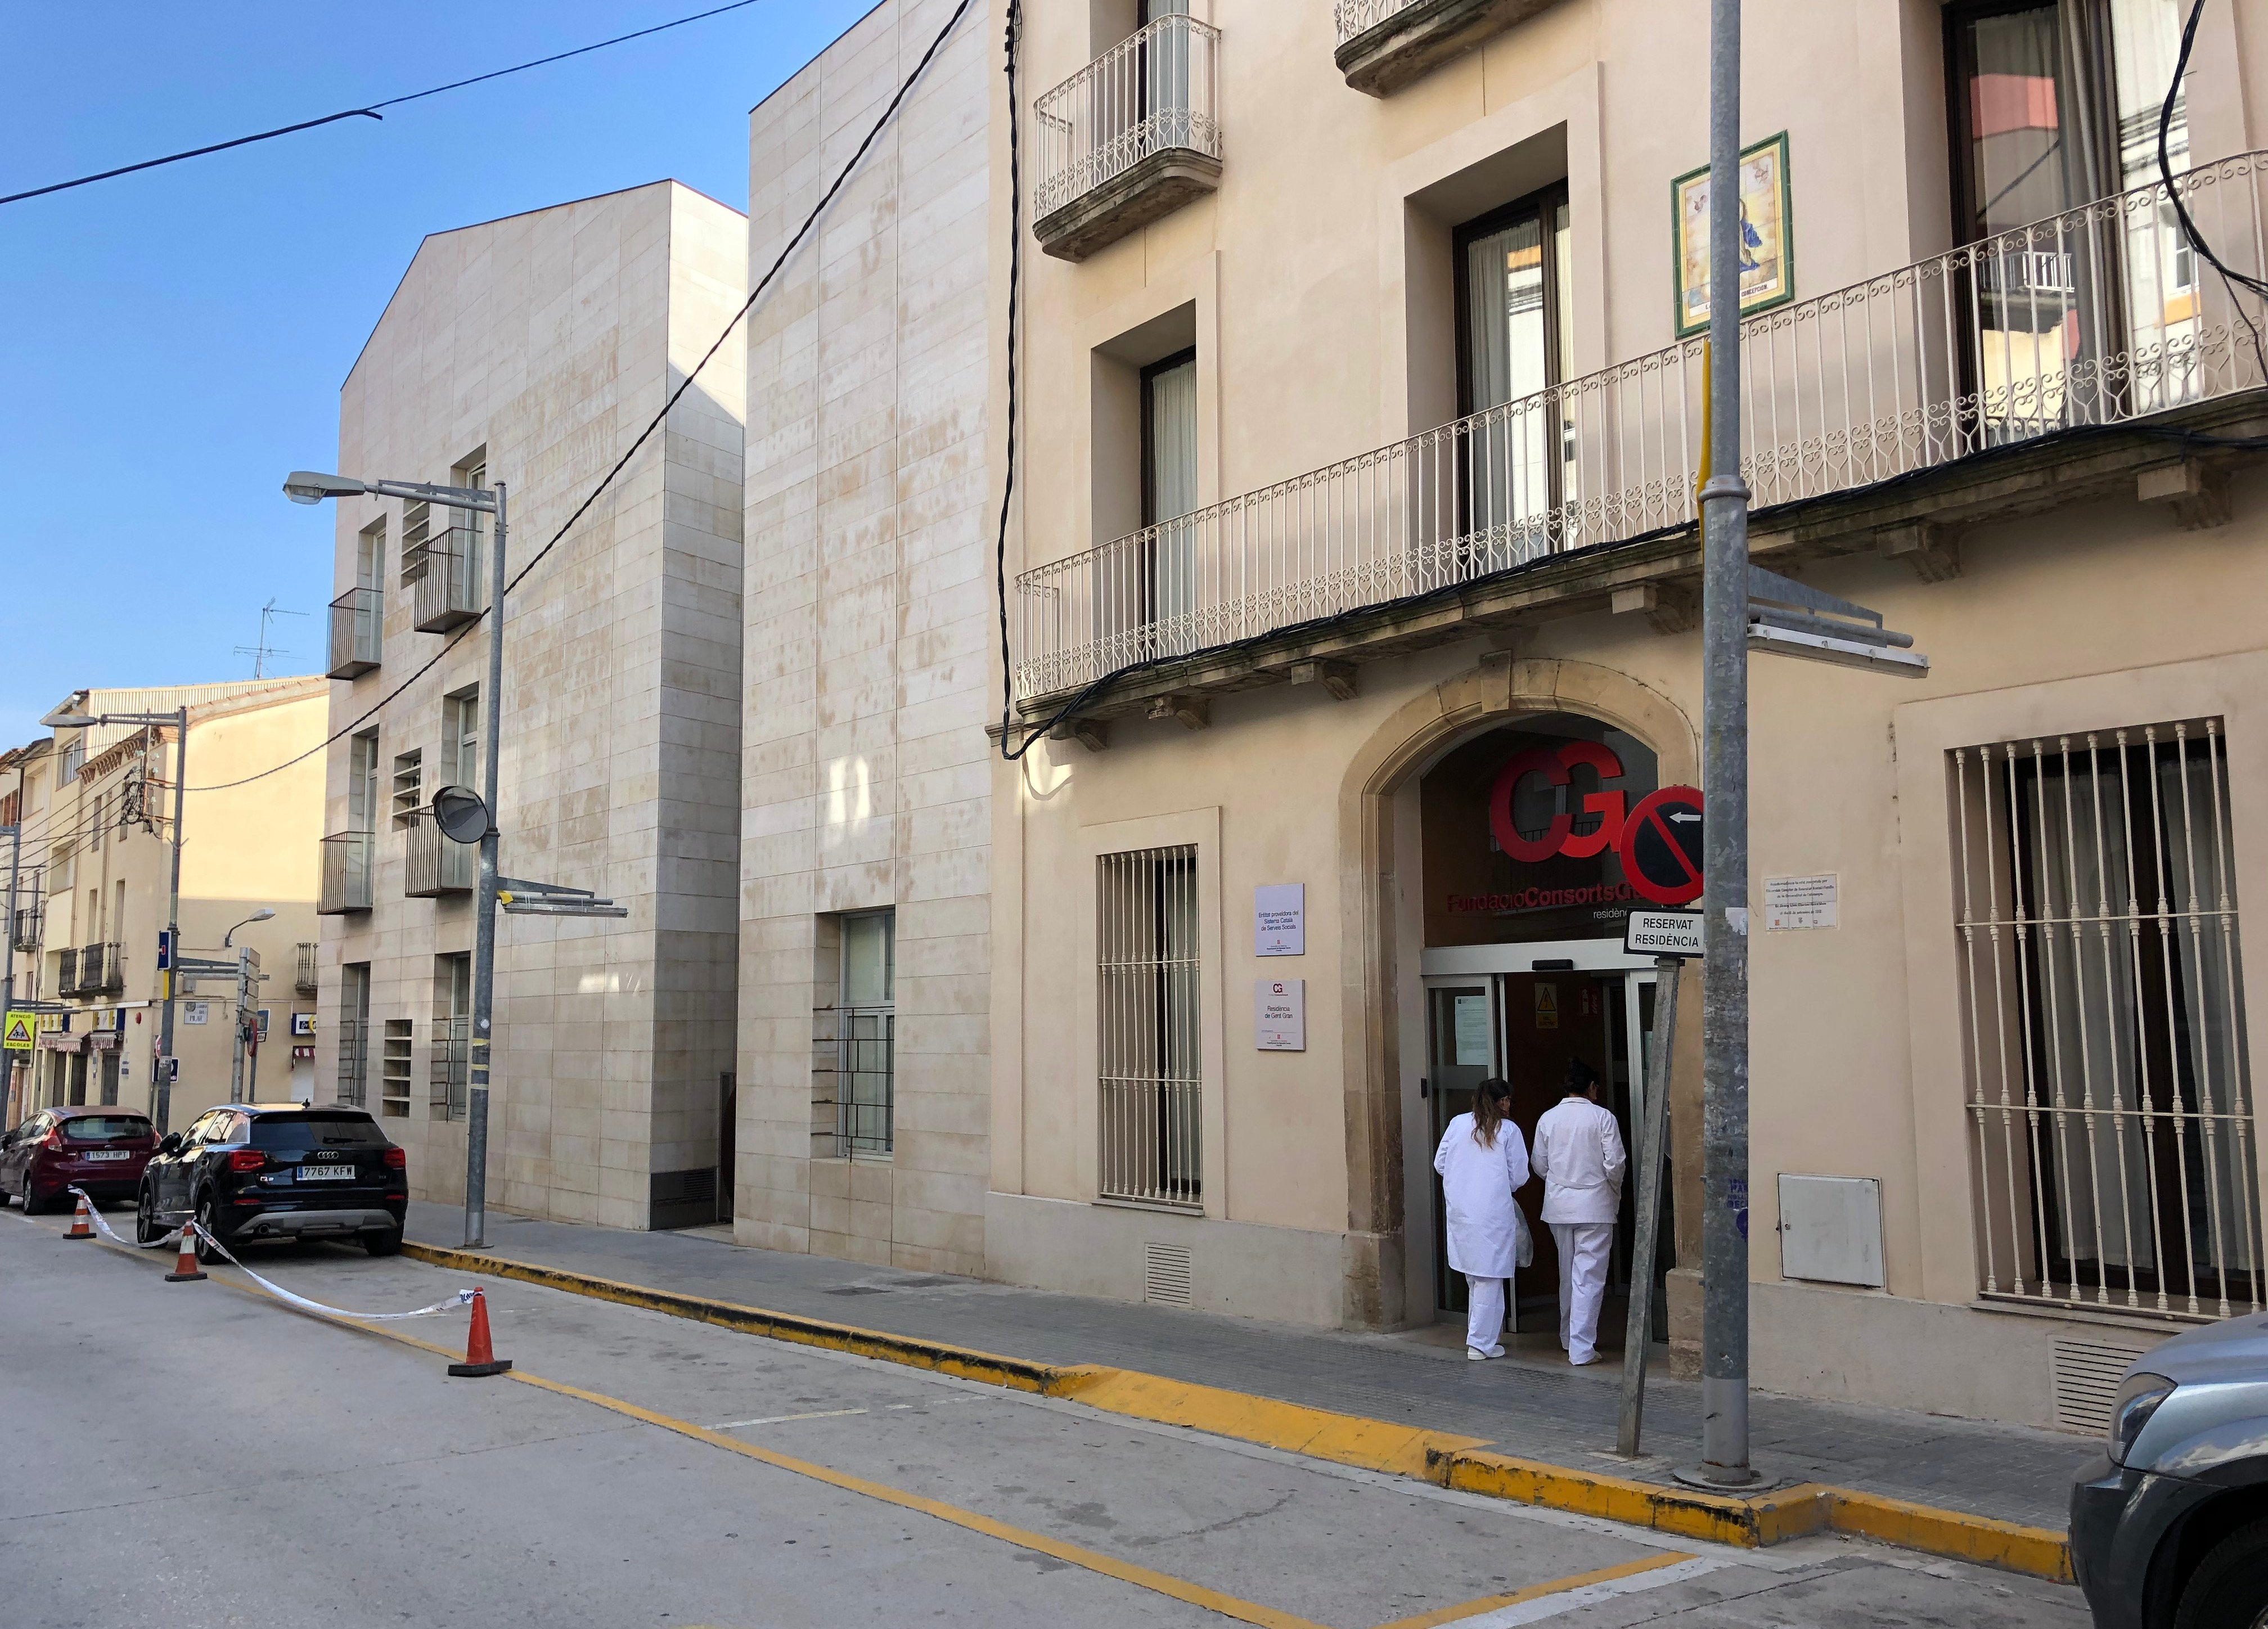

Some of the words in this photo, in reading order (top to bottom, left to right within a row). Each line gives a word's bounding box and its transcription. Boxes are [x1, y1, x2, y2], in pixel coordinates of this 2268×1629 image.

[1490, 741, 1626, 862] CG
[1642, 917, 1694, 930] RESERVAT
[1635, 933, 1699, 947] RESIDÈNCIA
[304, 1167, 330, 1177] 7767
[334, 1166, 352, 1176] KFW
